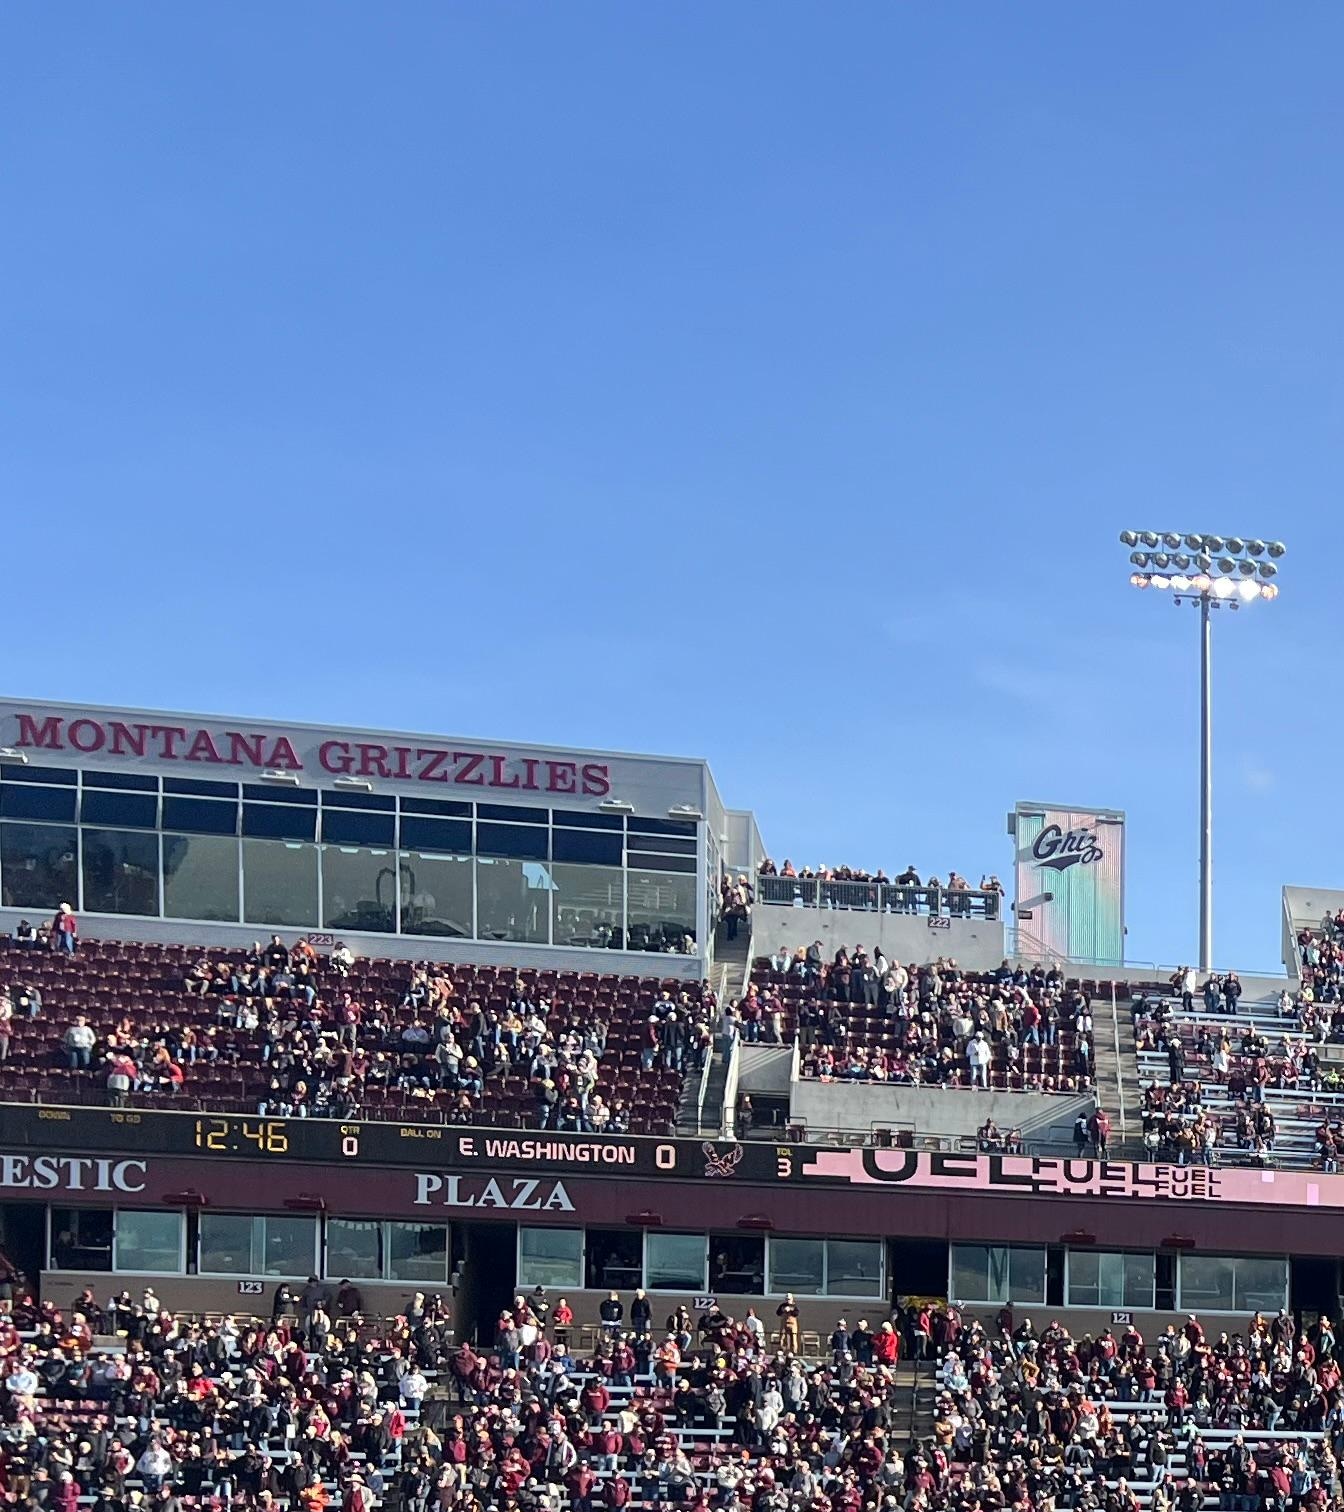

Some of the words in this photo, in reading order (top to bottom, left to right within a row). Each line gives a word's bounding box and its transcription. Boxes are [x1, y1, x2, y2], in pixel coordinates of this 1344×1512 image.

[15, 714, 303, 769] MONTANA
[319, 740, 610, 796] GRIZZLIES
[1033, 824, 1104, 864] Griz
[930, 917, 949, 927] 222
[310, 934, 332, 944] 223
[111, 1113, 124, 1123] TO
[196, 1119, 288, 1152] 12:46
[340, 1125, 360, 1135] QTR
[400, 1128, 423, 1138] BALL
[427, 1130, 442, 1139] ON
[342, 1136, 358, 1156] 0
[459, 1137, 478, 1156] E.
[486, 1139, 635, 1164] WASHINGTON
[655, 1144, 676, 1169] 0
[0, 1155, 147, 1192] ESTIC
[777, 1158, 792, 1177] 3
[1155, 1166, 1221, 1184] FUEL
[413, 1173, 576, 1212] PLAZA
[1155, 1183, 1221, 1197] FUEL
[240, 1281, 262, 1293] 123
[694, 1297, 716, 1309] 122
[1113, 1312, 1130, 1324] 121
